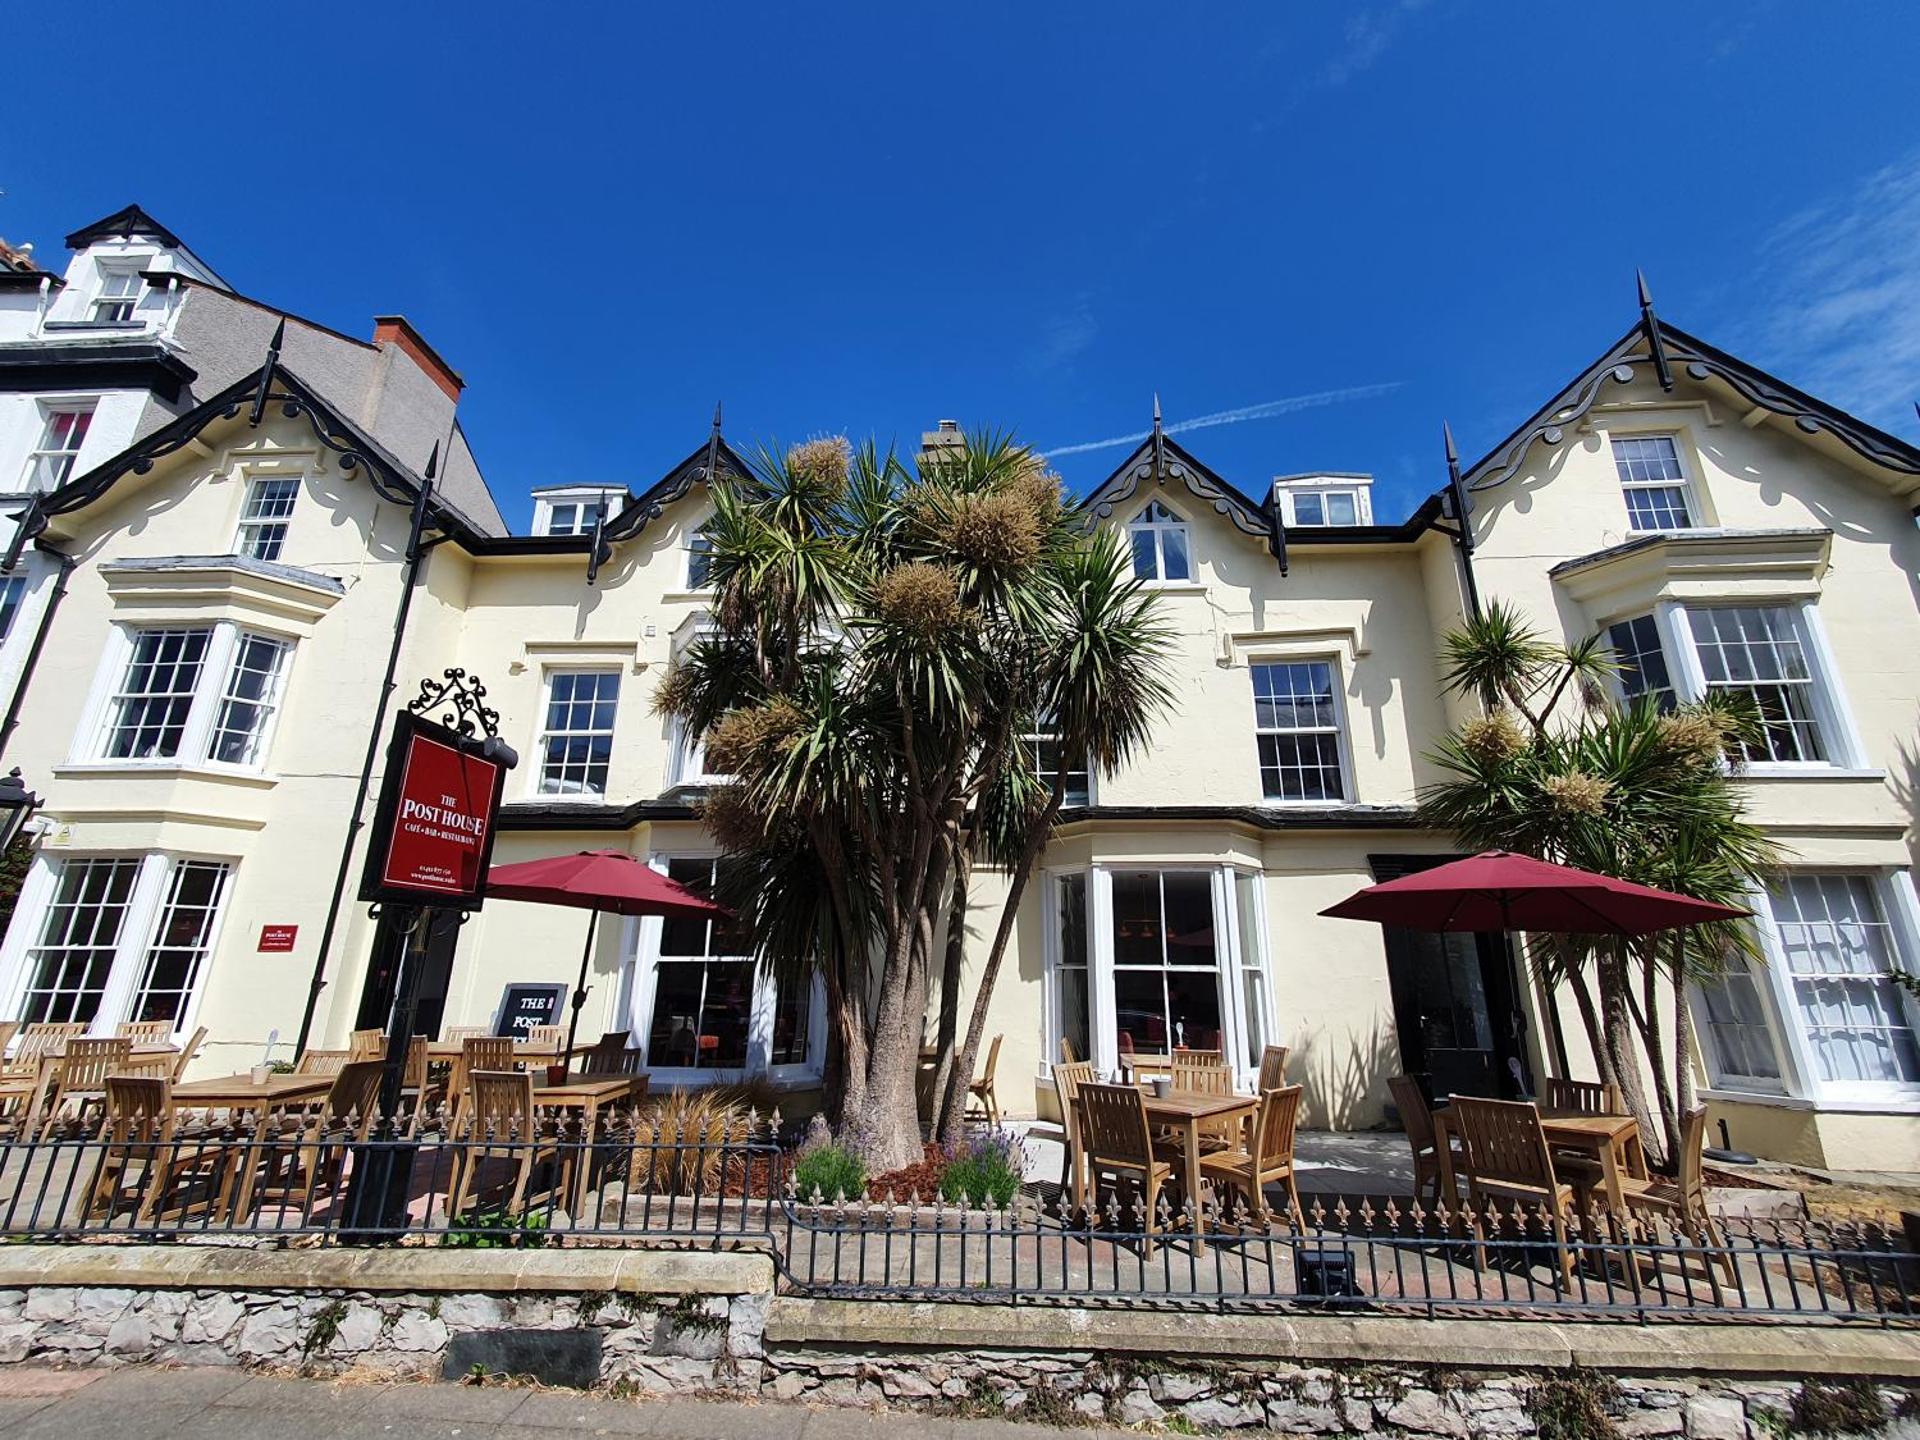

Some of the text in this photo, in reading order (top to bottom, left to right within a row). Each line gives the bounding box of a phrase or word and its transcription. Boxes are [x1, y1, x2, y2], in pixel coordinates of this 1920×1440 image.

[441, 794, 457, 808] THE
[402, 798, 484, 836] POST HOUSE
[404, 822, 476, 846] CAFÉ BAR RESTAURANT
[521, 997, 546, 1009] THE
[512, 1016, 543, 1028] POST
